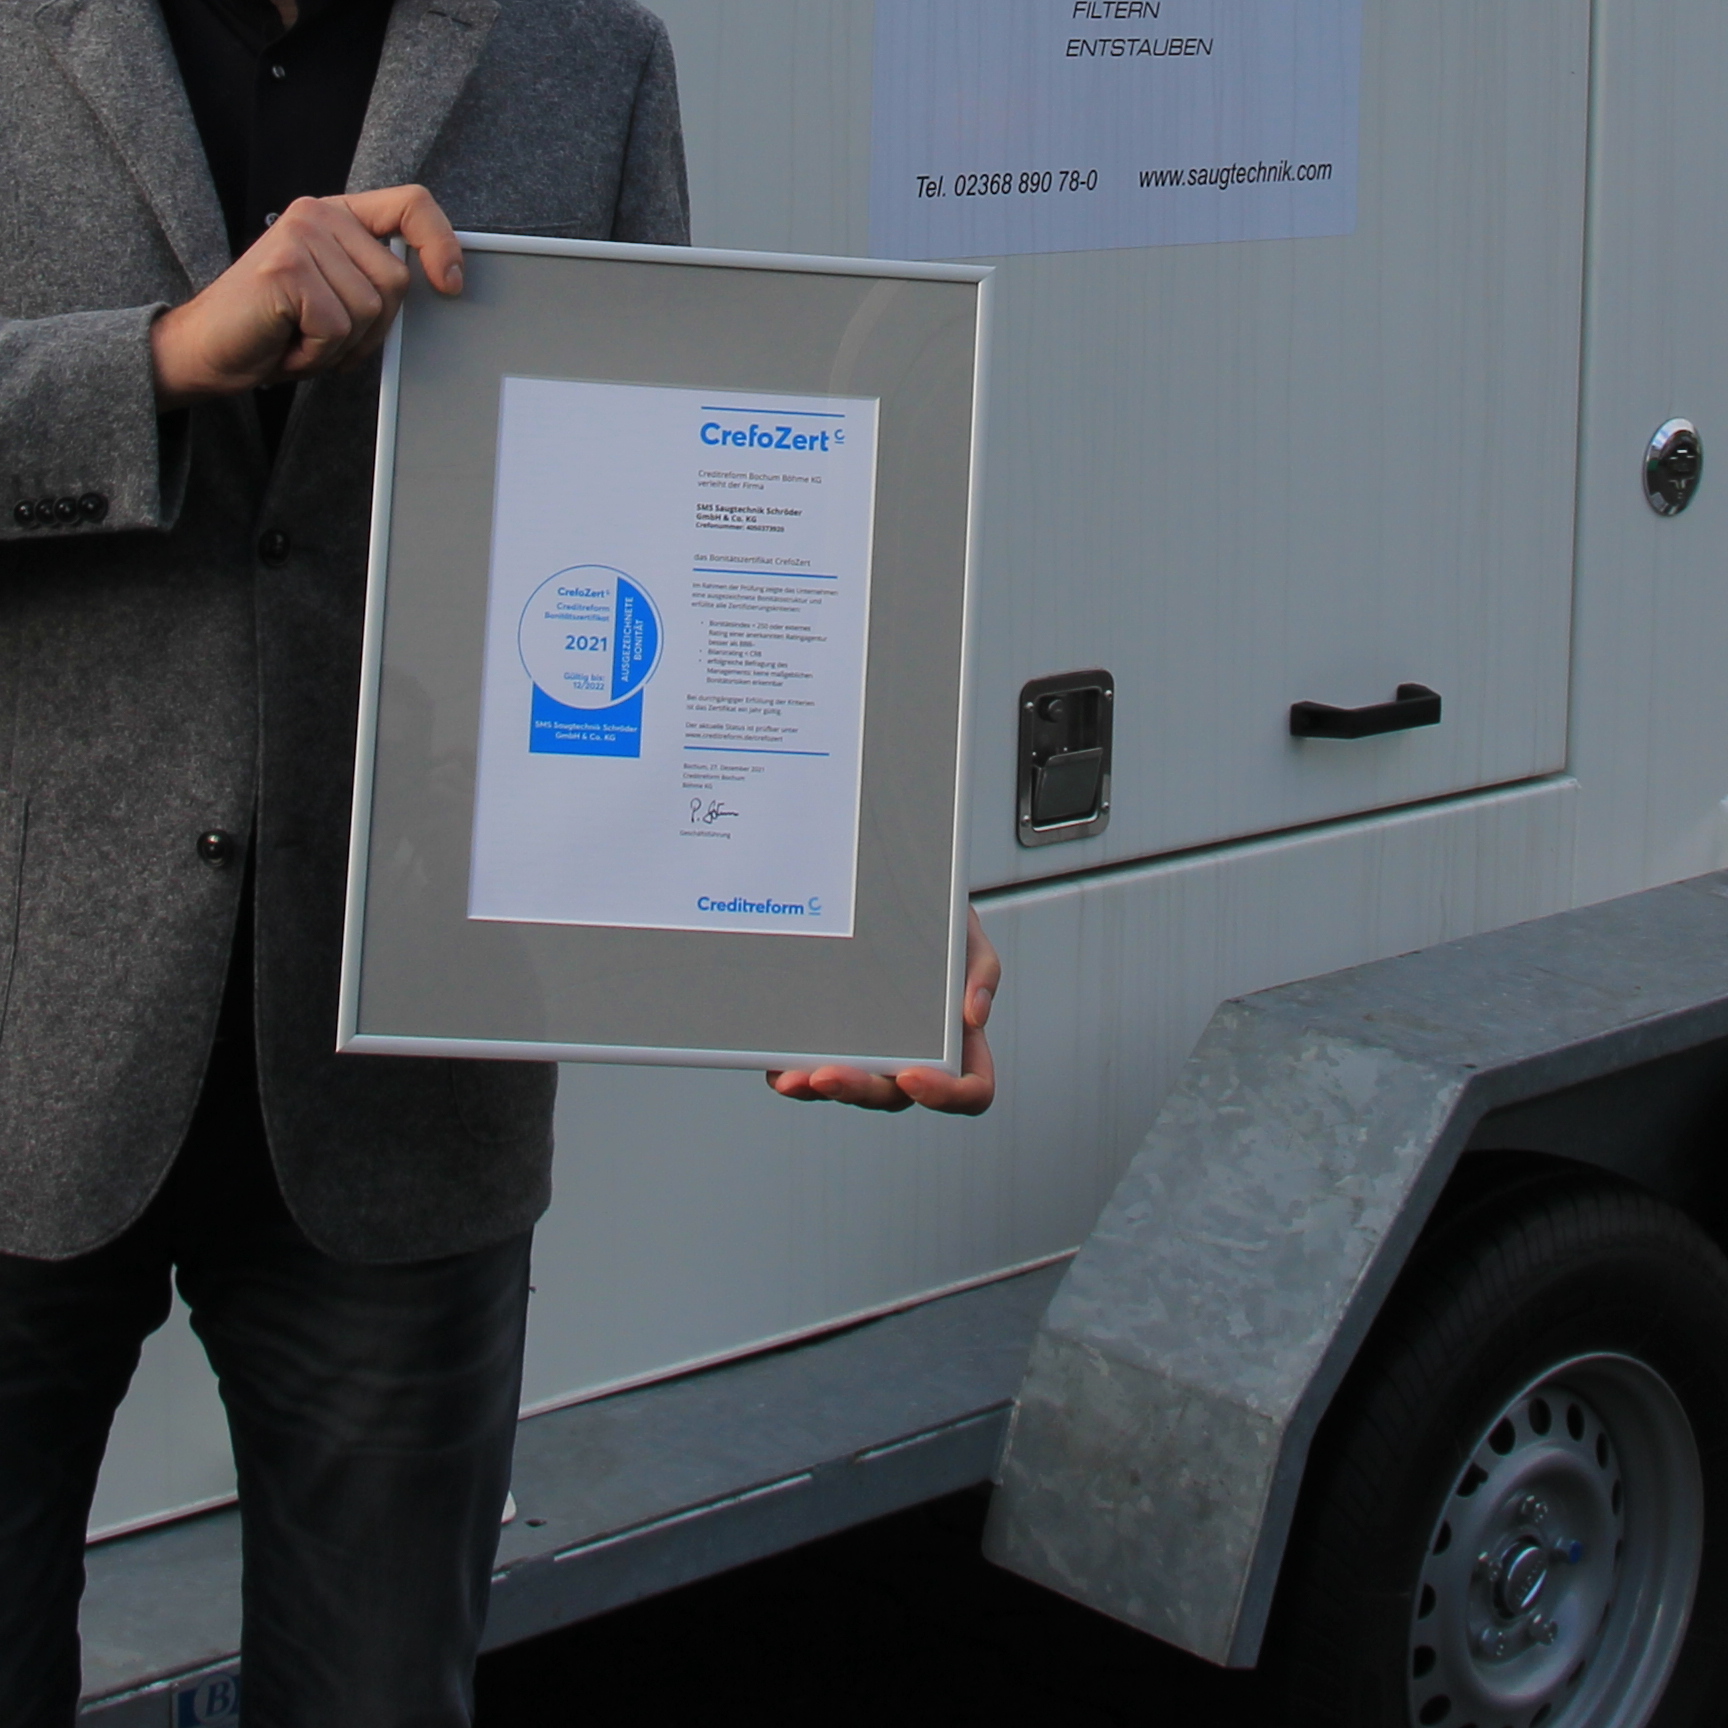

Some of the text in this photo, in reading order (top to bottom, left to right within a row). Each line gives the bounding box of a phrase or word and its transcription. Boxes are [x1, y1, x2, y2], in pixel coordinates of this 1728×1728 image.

[1072, 1, 1160, 18] FILTERN
[1066, 38, 1213, 56] ENTSTAUBEN
[1139, 160, 1332, 189] www.saugtechnik.com
[916, 170, 1098, 198] Tel. 02368 890 78-0
[700, 422, 829, 452] CrefoZert
[698, 470, 747, 479] Creditreform
[749, 473, 780, 481] Bochum
[782, 474, 809, 483] Böhme
[728, 481, 740, 489] der
[715, 505, 764, 515] Saugtechnik
[766, 507, 802, 516] Schröder
[775, 558, 811, 566] CrefoZert
[558, 587, 605, 598] CrefoZert
[557, 602, 610, 612] Creditreform
[565, 635, 607, 652] 2021
[621, 596, 634, 682] AUSGEZEICHNETE
[633, 620, 644, 660] BONITÄT
[573, 681, 605, 691] 12/2022
[697, 896, 804, 915] Creditreform
